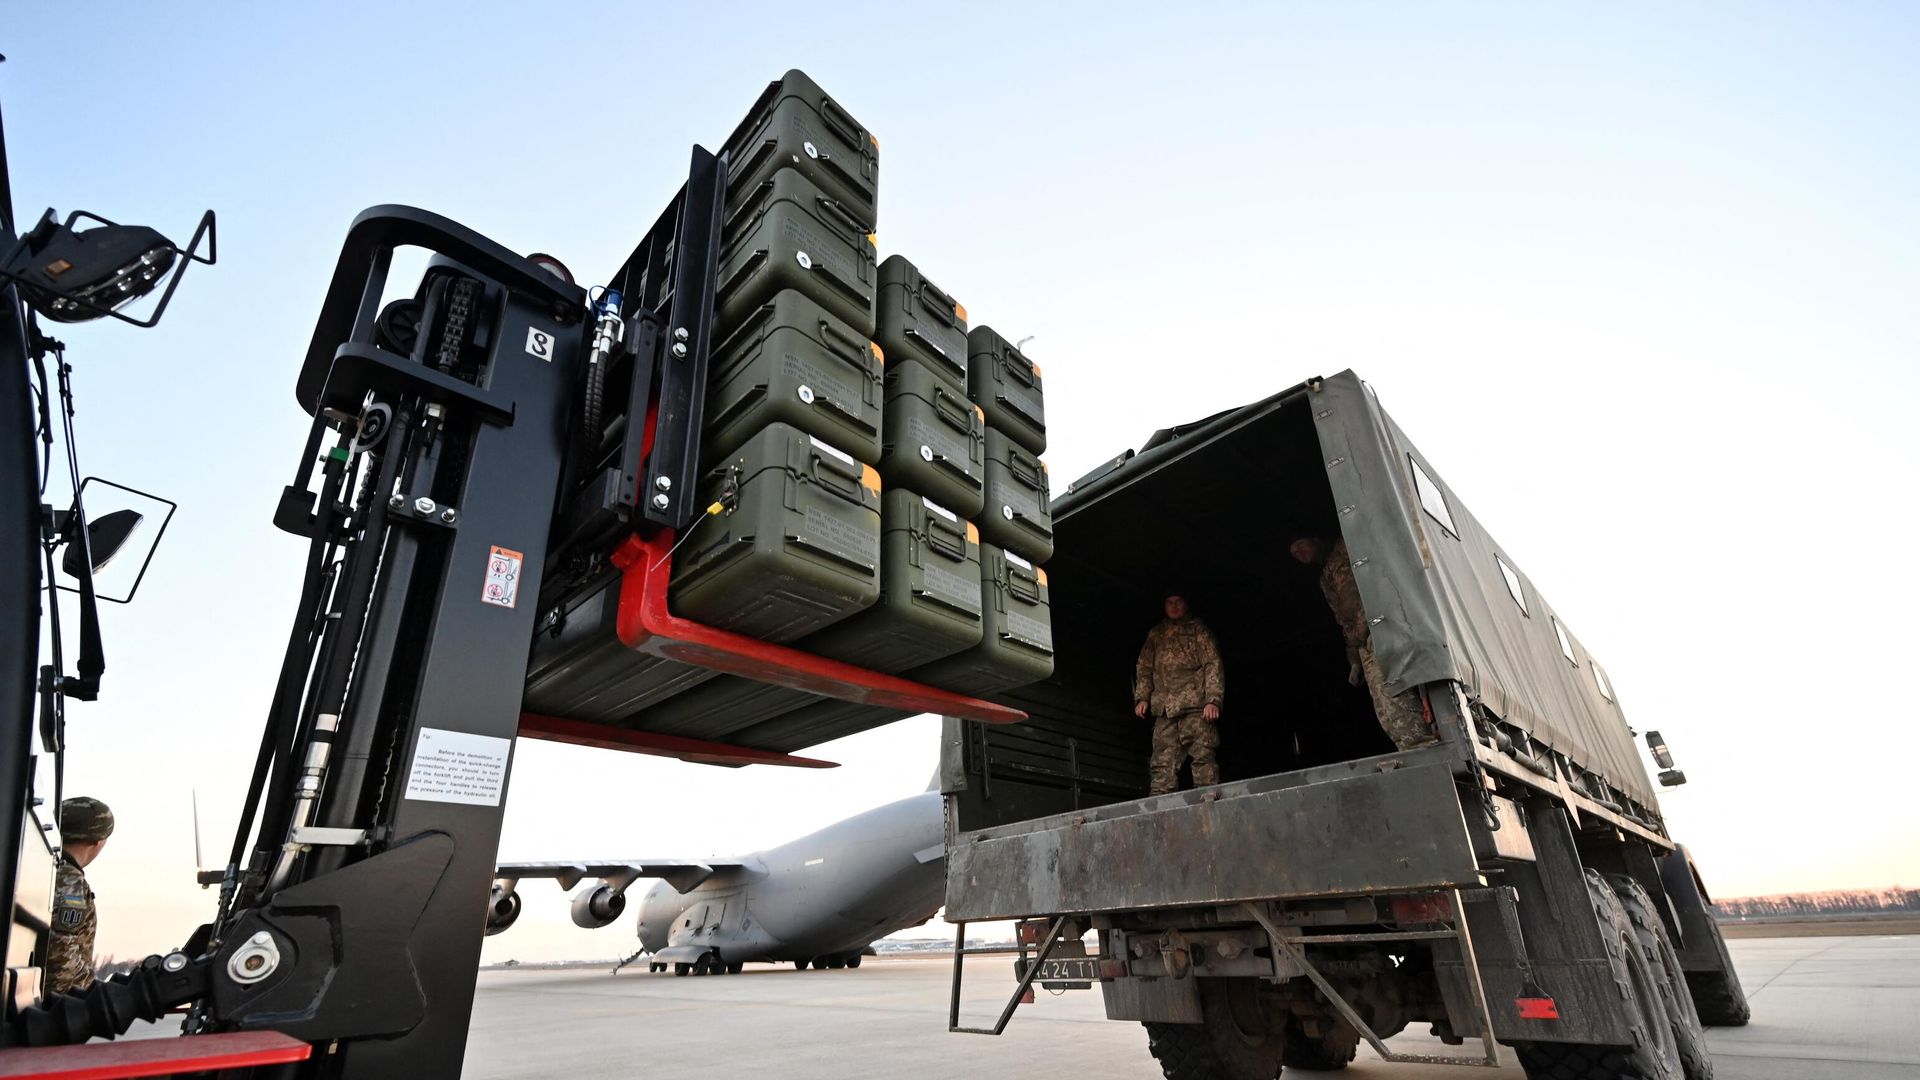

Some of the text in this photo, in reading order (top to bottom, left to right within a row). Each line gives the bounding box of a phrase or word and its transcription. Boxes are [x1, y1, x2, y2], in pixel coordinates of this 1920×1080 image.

[462, 767, 479, 775] should
[1053, 962, 1070, 978] 24
[1076, 961, 1095, 978] T1
